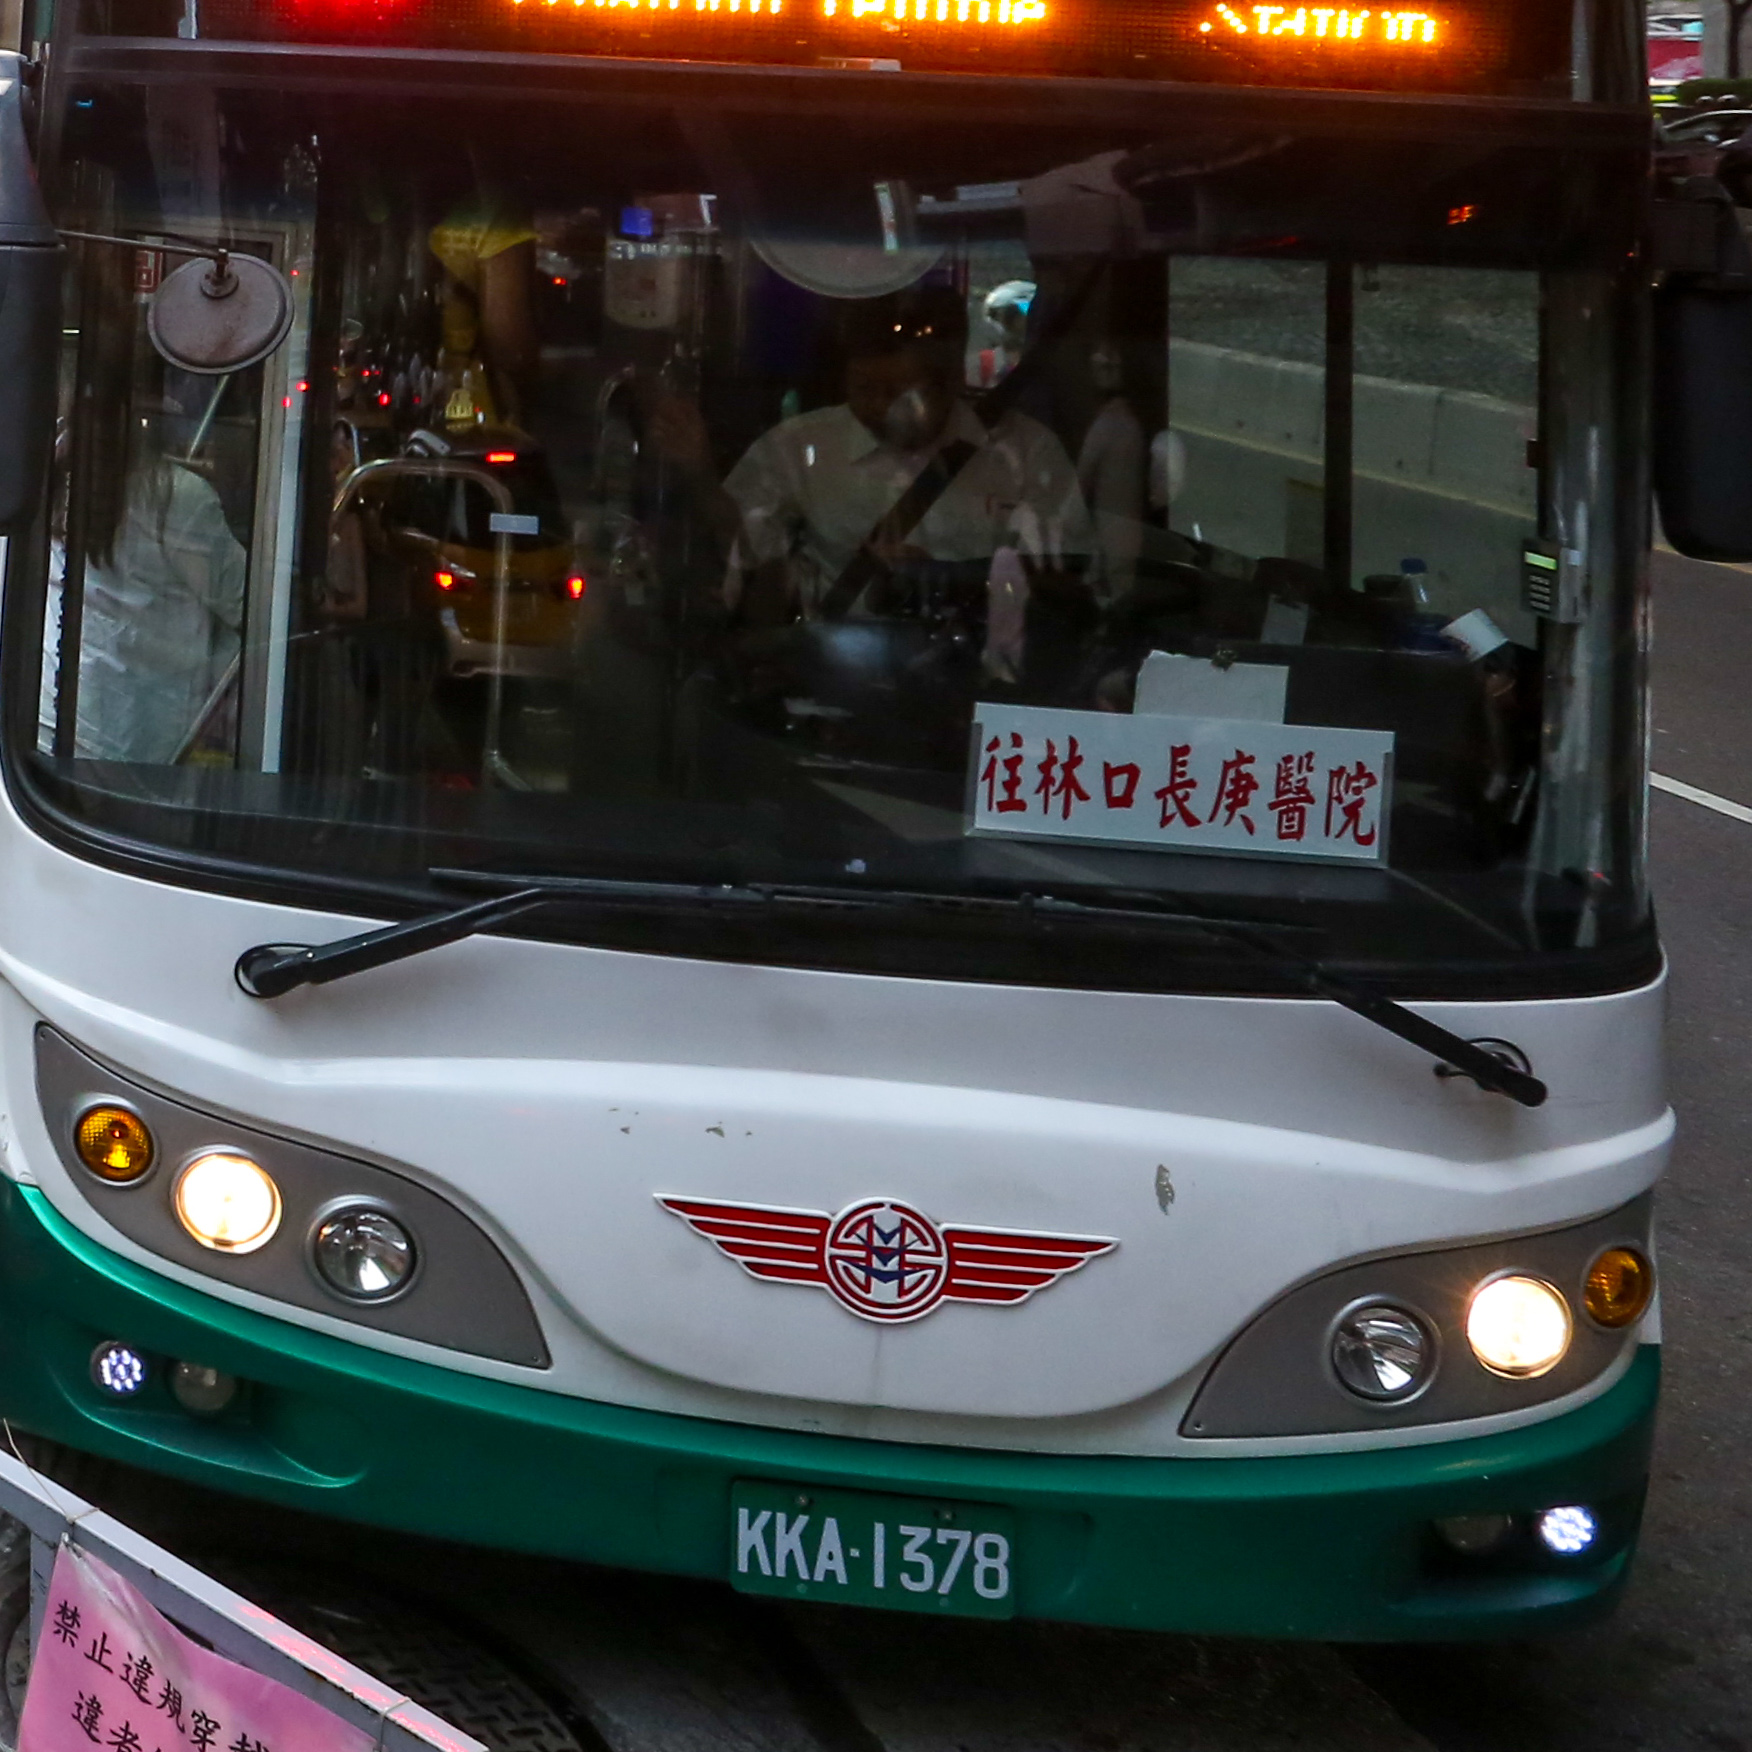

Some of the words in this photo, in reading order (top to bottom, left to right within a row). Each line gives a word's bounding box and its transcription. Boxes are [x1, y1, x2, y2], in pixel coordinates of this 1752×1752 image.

[980, 731, 1379, 847] 往林口長庚醫院
[736, 1507, 1010, 1601] KKA-1378
[71, 1690, 163, 1752] 違者
